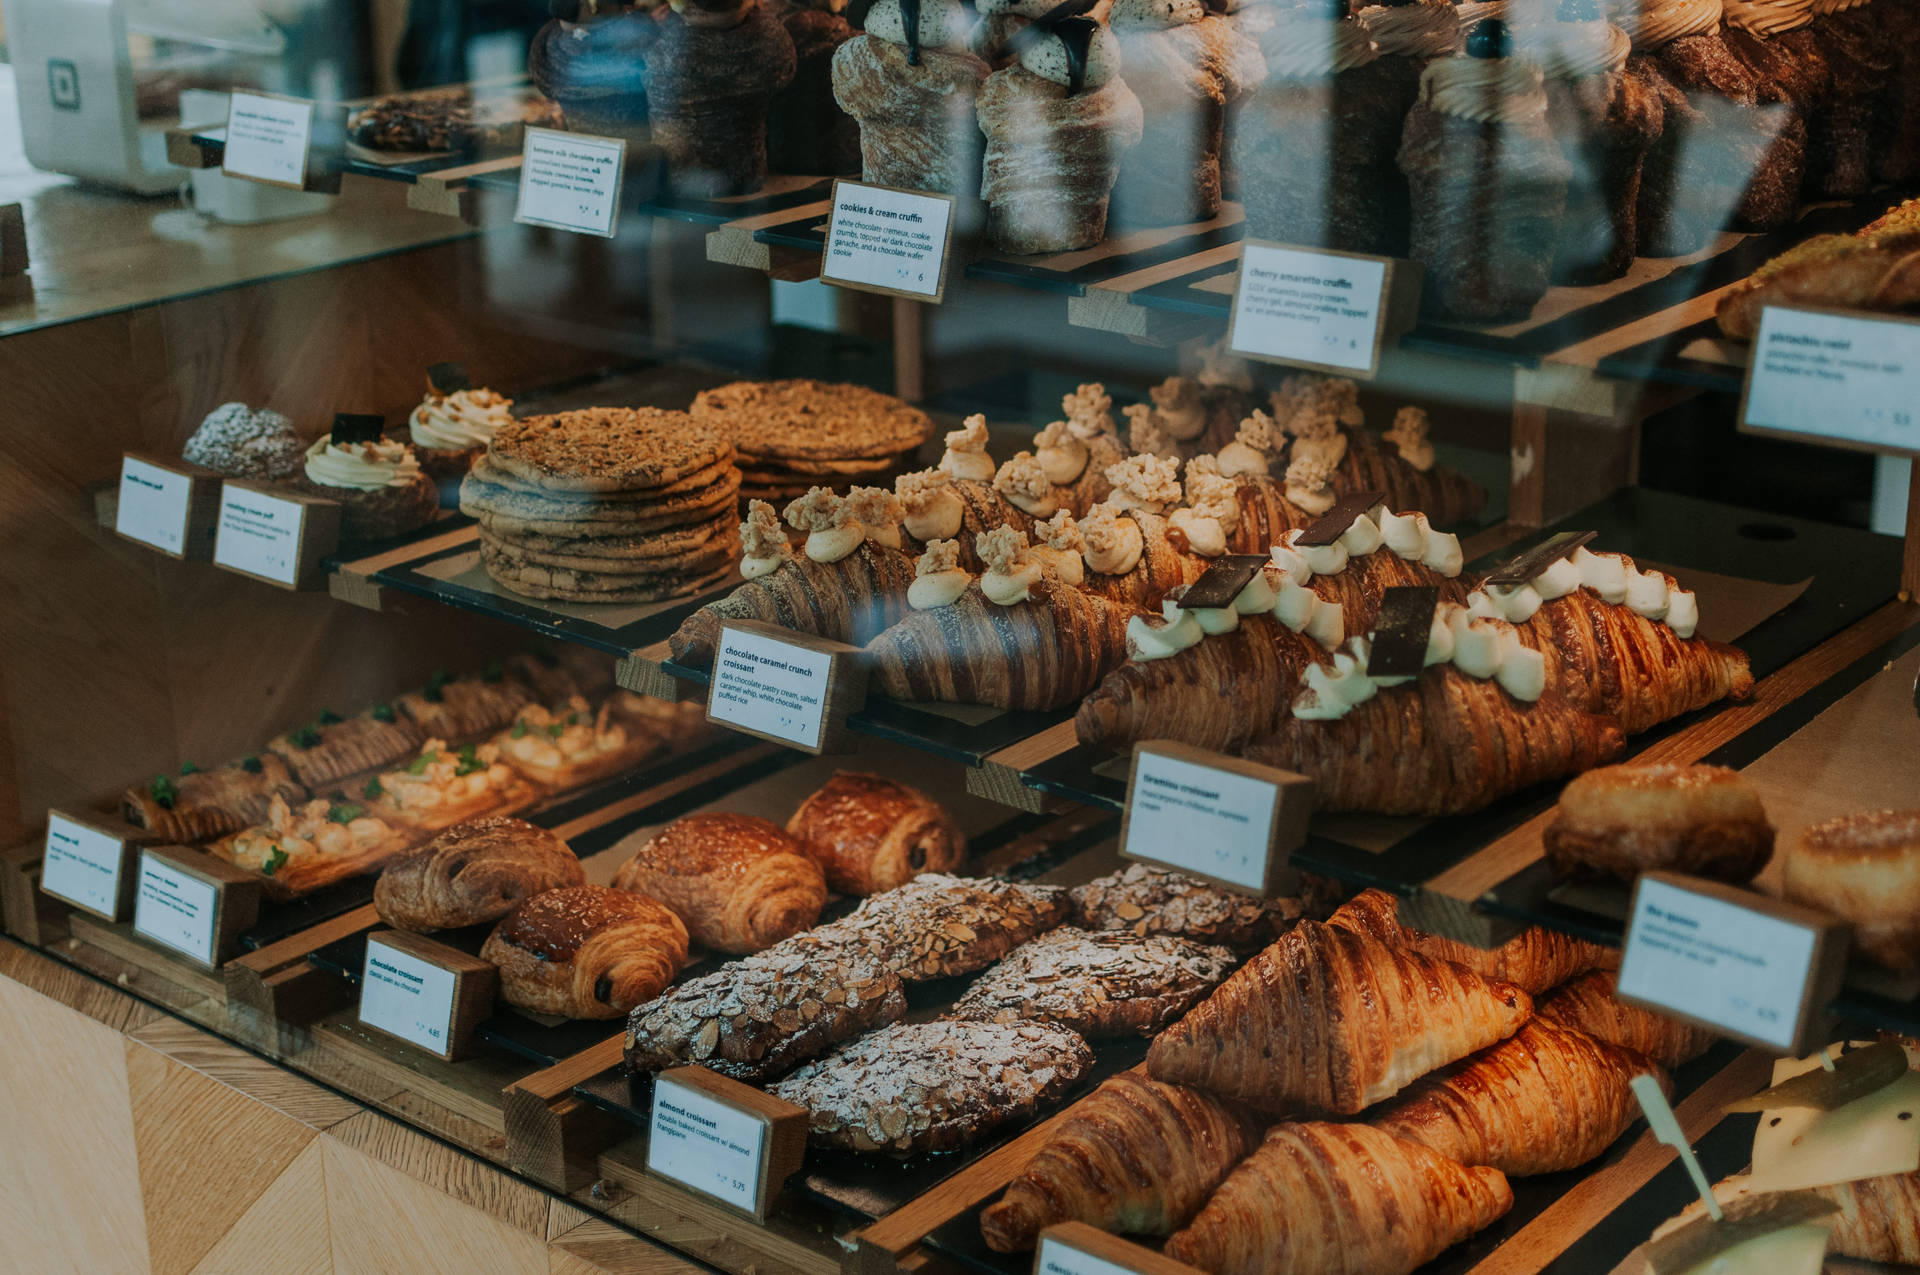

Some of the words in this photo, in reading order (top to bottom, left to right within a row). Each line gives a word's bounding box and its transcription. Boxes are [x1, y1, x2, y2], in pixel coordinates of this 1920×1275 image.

[840, 202, 867, 214] cookies
[868, 207, 874, 215] &
[875, 209, 897, 219] cream
[899, 212, 923, 223] cruffin
[836, 228, 858, 239] crumbs,
[860, 232, 881, 243] topped
[882, 236, 889, 244] w/
[890, 238, 903, 246] dark
[905, 240, 933, 252] chocolate
[838, 218, 853, 226] white
[855, 221, 881, 232] chocolate
[883, 227, 909, 238] cremeux,
[911, 232, 930, 241] cookie
[833, 248, 852, 257] cookie
[835, 240, 859, 250] ganache,
[861, 242, 872, 251] and
[878, 246, 906, 258] chocolate
[907, 251, 924, 260] wafer
[918, 273, 924, 281] 6
[1250, 268, 1279, 281] cherry
[1280, 273, 1321, 285] amaretto
[1323, 278, 1353, 290] cruffin
[1341, 307, 1369, 319] topped
[723, 659, 755, 674] croissant
[725, 646, 759, 662] chocolate
[760, 656, 788, 670] caramel
[788, 663, 813, 677] crunch
[718, 691, 737, 702] puffed
[738, 696, 748, 705] rice
[720, 682, 742, 694] caramel
[743, 687, 758, 698] whip,
[758, 691, 775, 703] white
[775, 697, 802, 711] chocolate
[721, 671, 734, 681] dark
[734, 675, 761, 689] chocolate
[762, 682, 780, 695] pastry
[780, 687, 799, 700] cream,
[800, 693, 818, 705] salted
[801, 723, 806, 732] 7
[1143, 774, 1178, 790] tiramisu
[1180, 784, 1220, 799] croissant
[370, 957, 398, 974] chocolate
[398, 969, 424, 985] croissant
[659, 1100, 685, 1116] almond
[686, 1111, 717, 1129] croissant
[657, 1122, 686, 1140] frangipane
[658, 1112, 677, 1125] double
[678, 1119, 695, 1133] baked
[695, 1127, 720, 1144] croissant
[721, 1138, 728, 1146] w/
[729, 1141, 750, 1157] almond
[732, 1179, 745, 1192] 5.75
